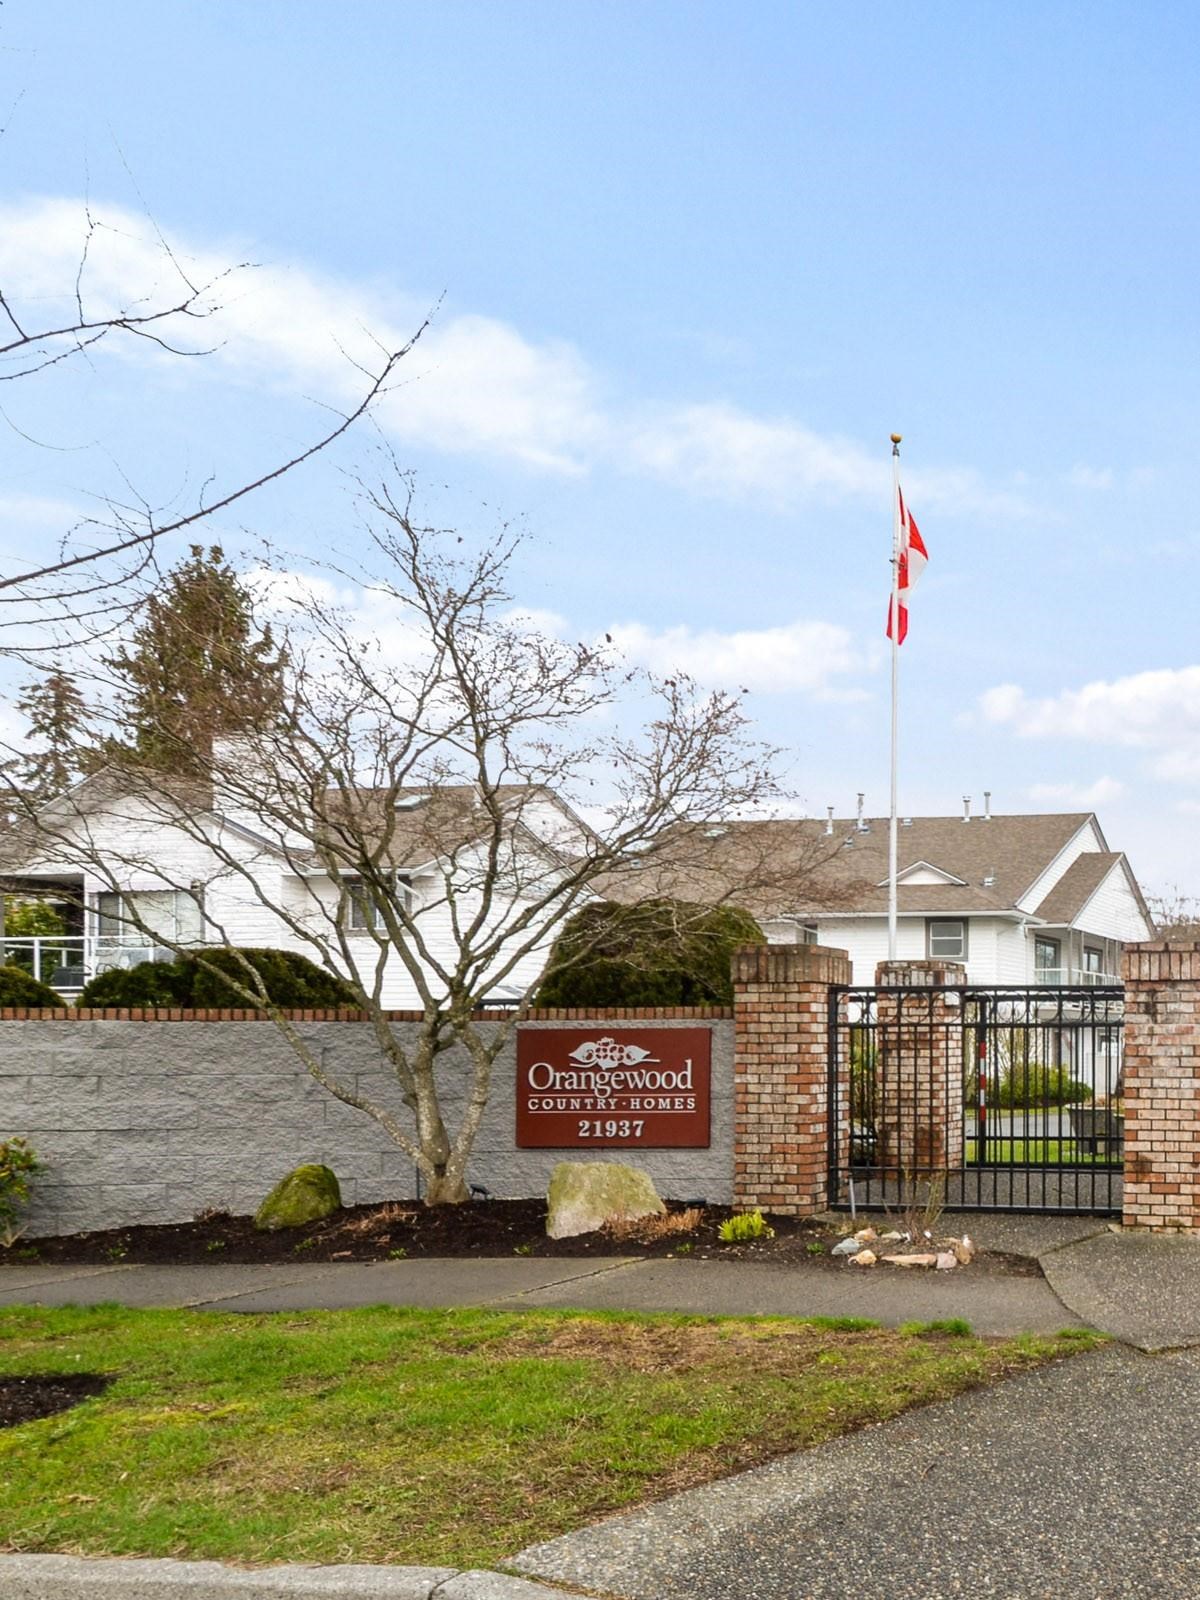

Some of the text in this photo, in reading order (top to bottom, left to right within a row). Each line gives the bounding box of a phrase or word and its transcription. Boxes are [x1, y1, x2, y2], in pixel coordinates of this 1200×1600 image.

[528, 1059, 693, 1098] Orangewood
[528, 1098, 696, 1110] COUNTRY HOMES
[578, 1120, 645, 1137] 21937
